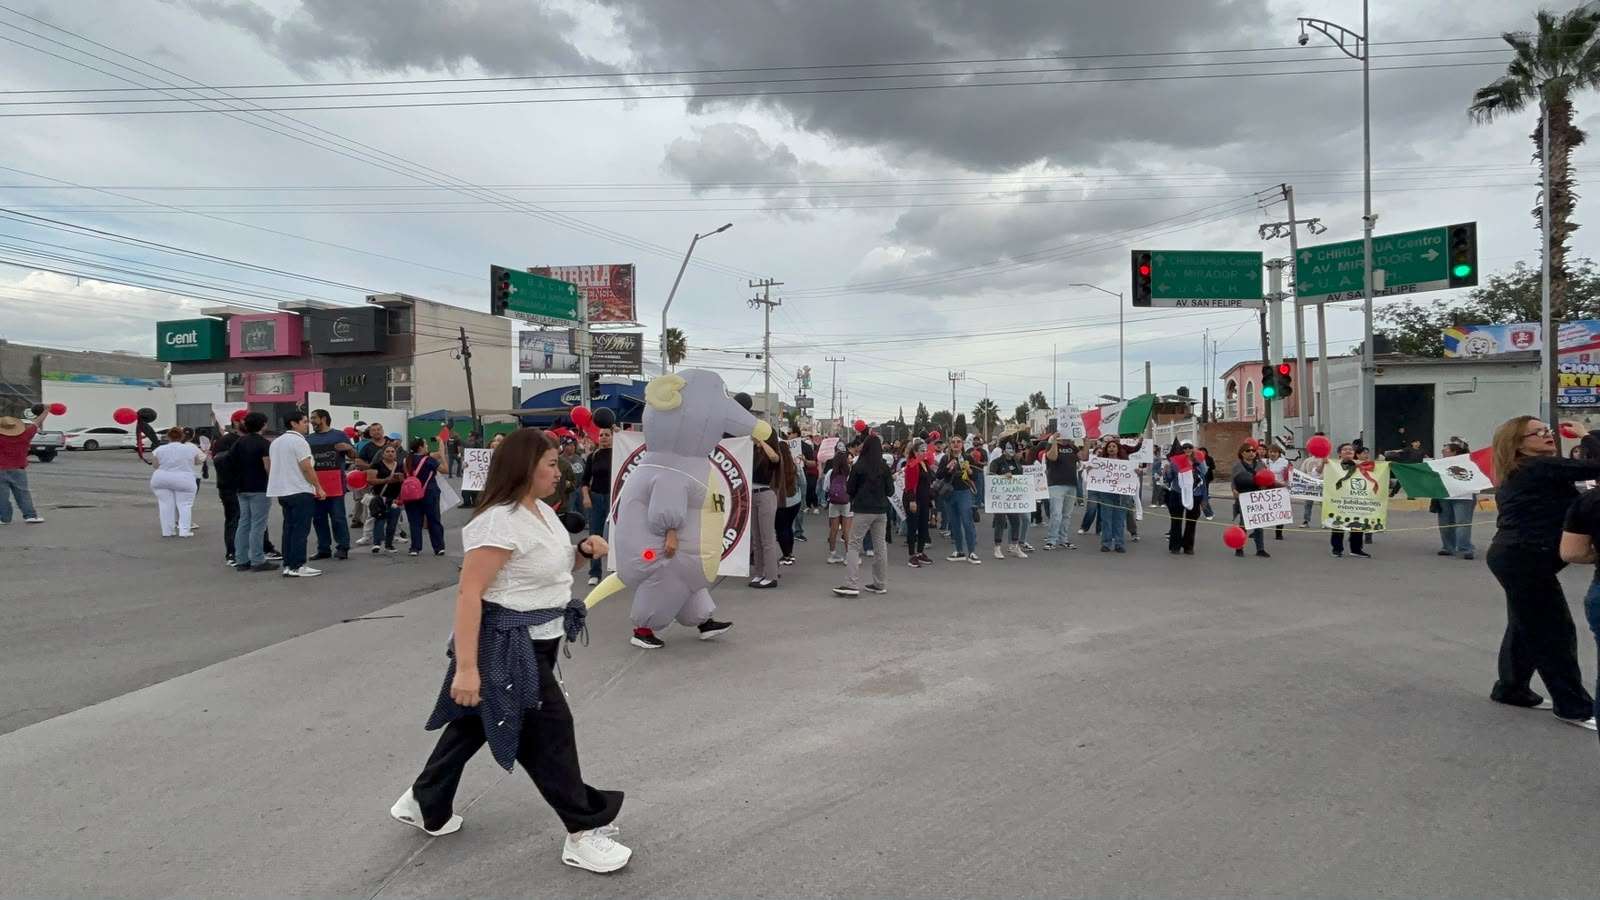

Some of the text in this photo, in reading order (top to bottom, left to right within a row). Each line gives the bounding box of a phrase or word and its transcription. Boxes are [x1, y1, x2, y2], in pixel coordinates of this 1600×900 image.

[1318, 235, 1442, 261] CHIHUAUA Centro
[1347, 289, 1365, 299] SA
[1191, 299, 1210, 308] SAN
[1212, 299, 1242, 308] FELIPE
[166, 330, 198, 345] Genit
[469, 450, 489, 463] SEG
[1091, 458, 1128, 471] Salario
[1106, 470, 1131, 480] Digno
[1250, 489, 1283, 503] BASES
[991, 501, 1030, 509] ROBLEDO
[1247, 501, 1282, 513] PARA LOS
